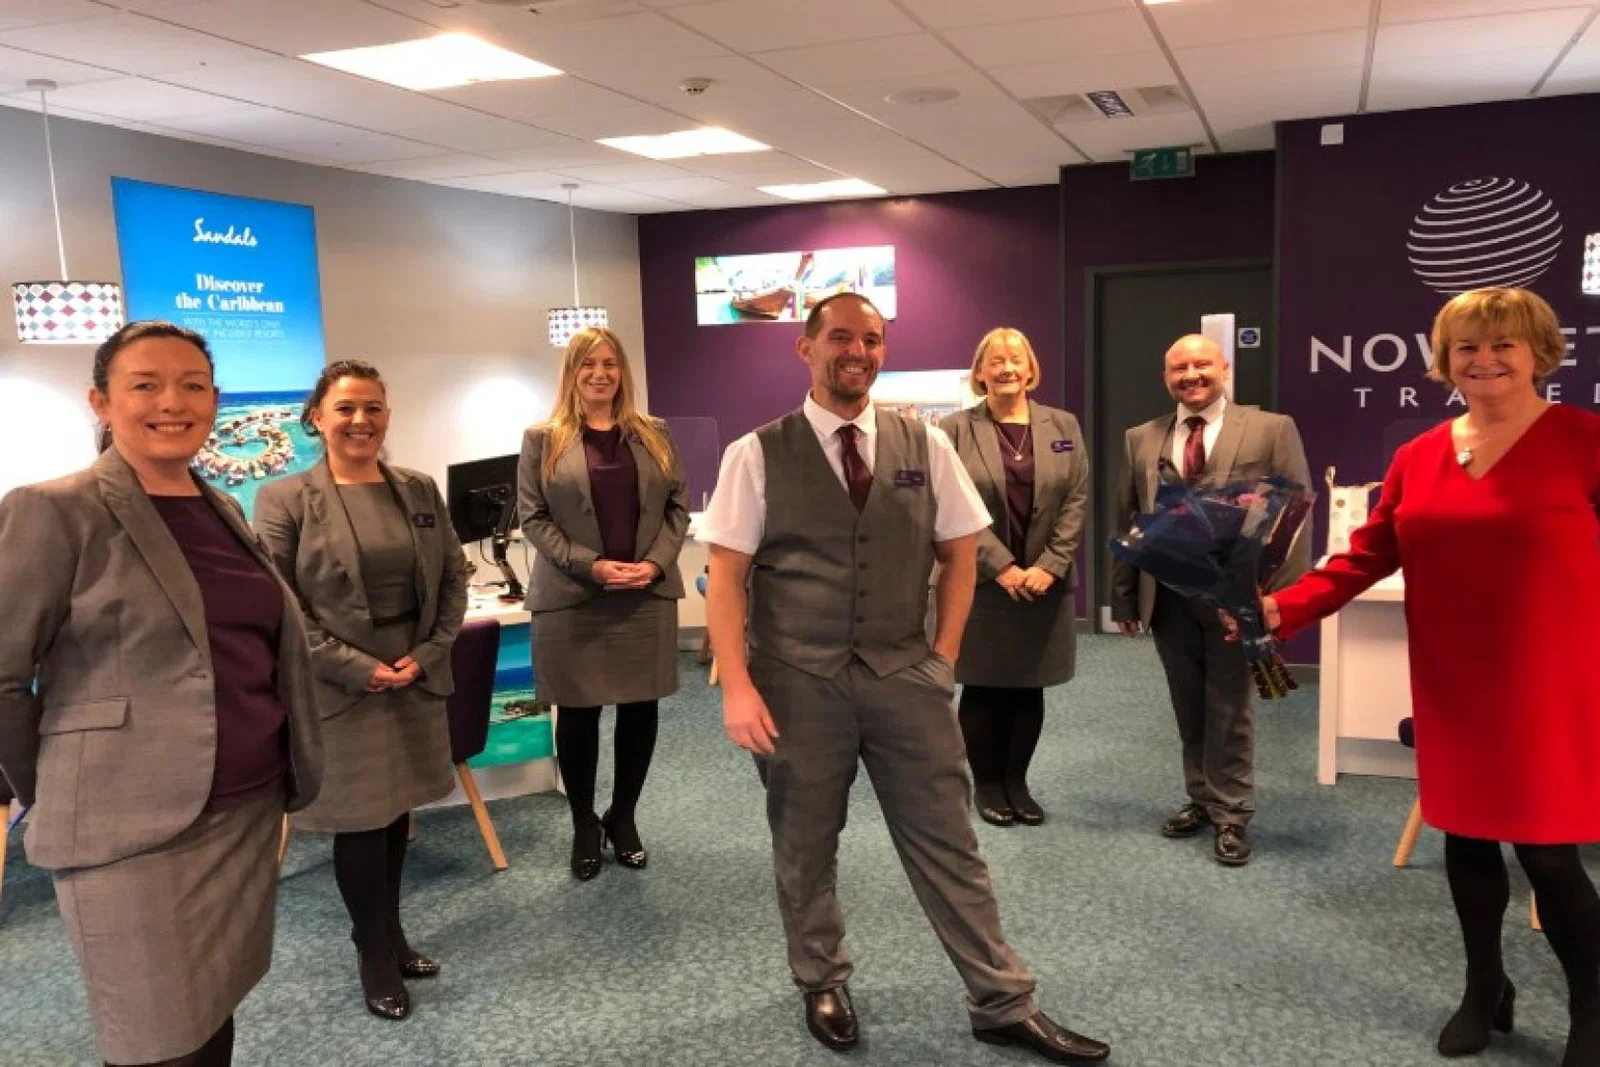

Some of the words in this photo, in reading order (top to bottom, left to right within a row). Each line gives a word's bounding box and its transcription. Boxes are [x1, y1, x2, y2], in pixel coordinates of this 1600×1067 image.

[193, 217, 258, 247] Sandals
[195, 273, 264, 294] Discover
[175, 292, 202, 310] the
[207, 294, 284, 313] Caribbean
